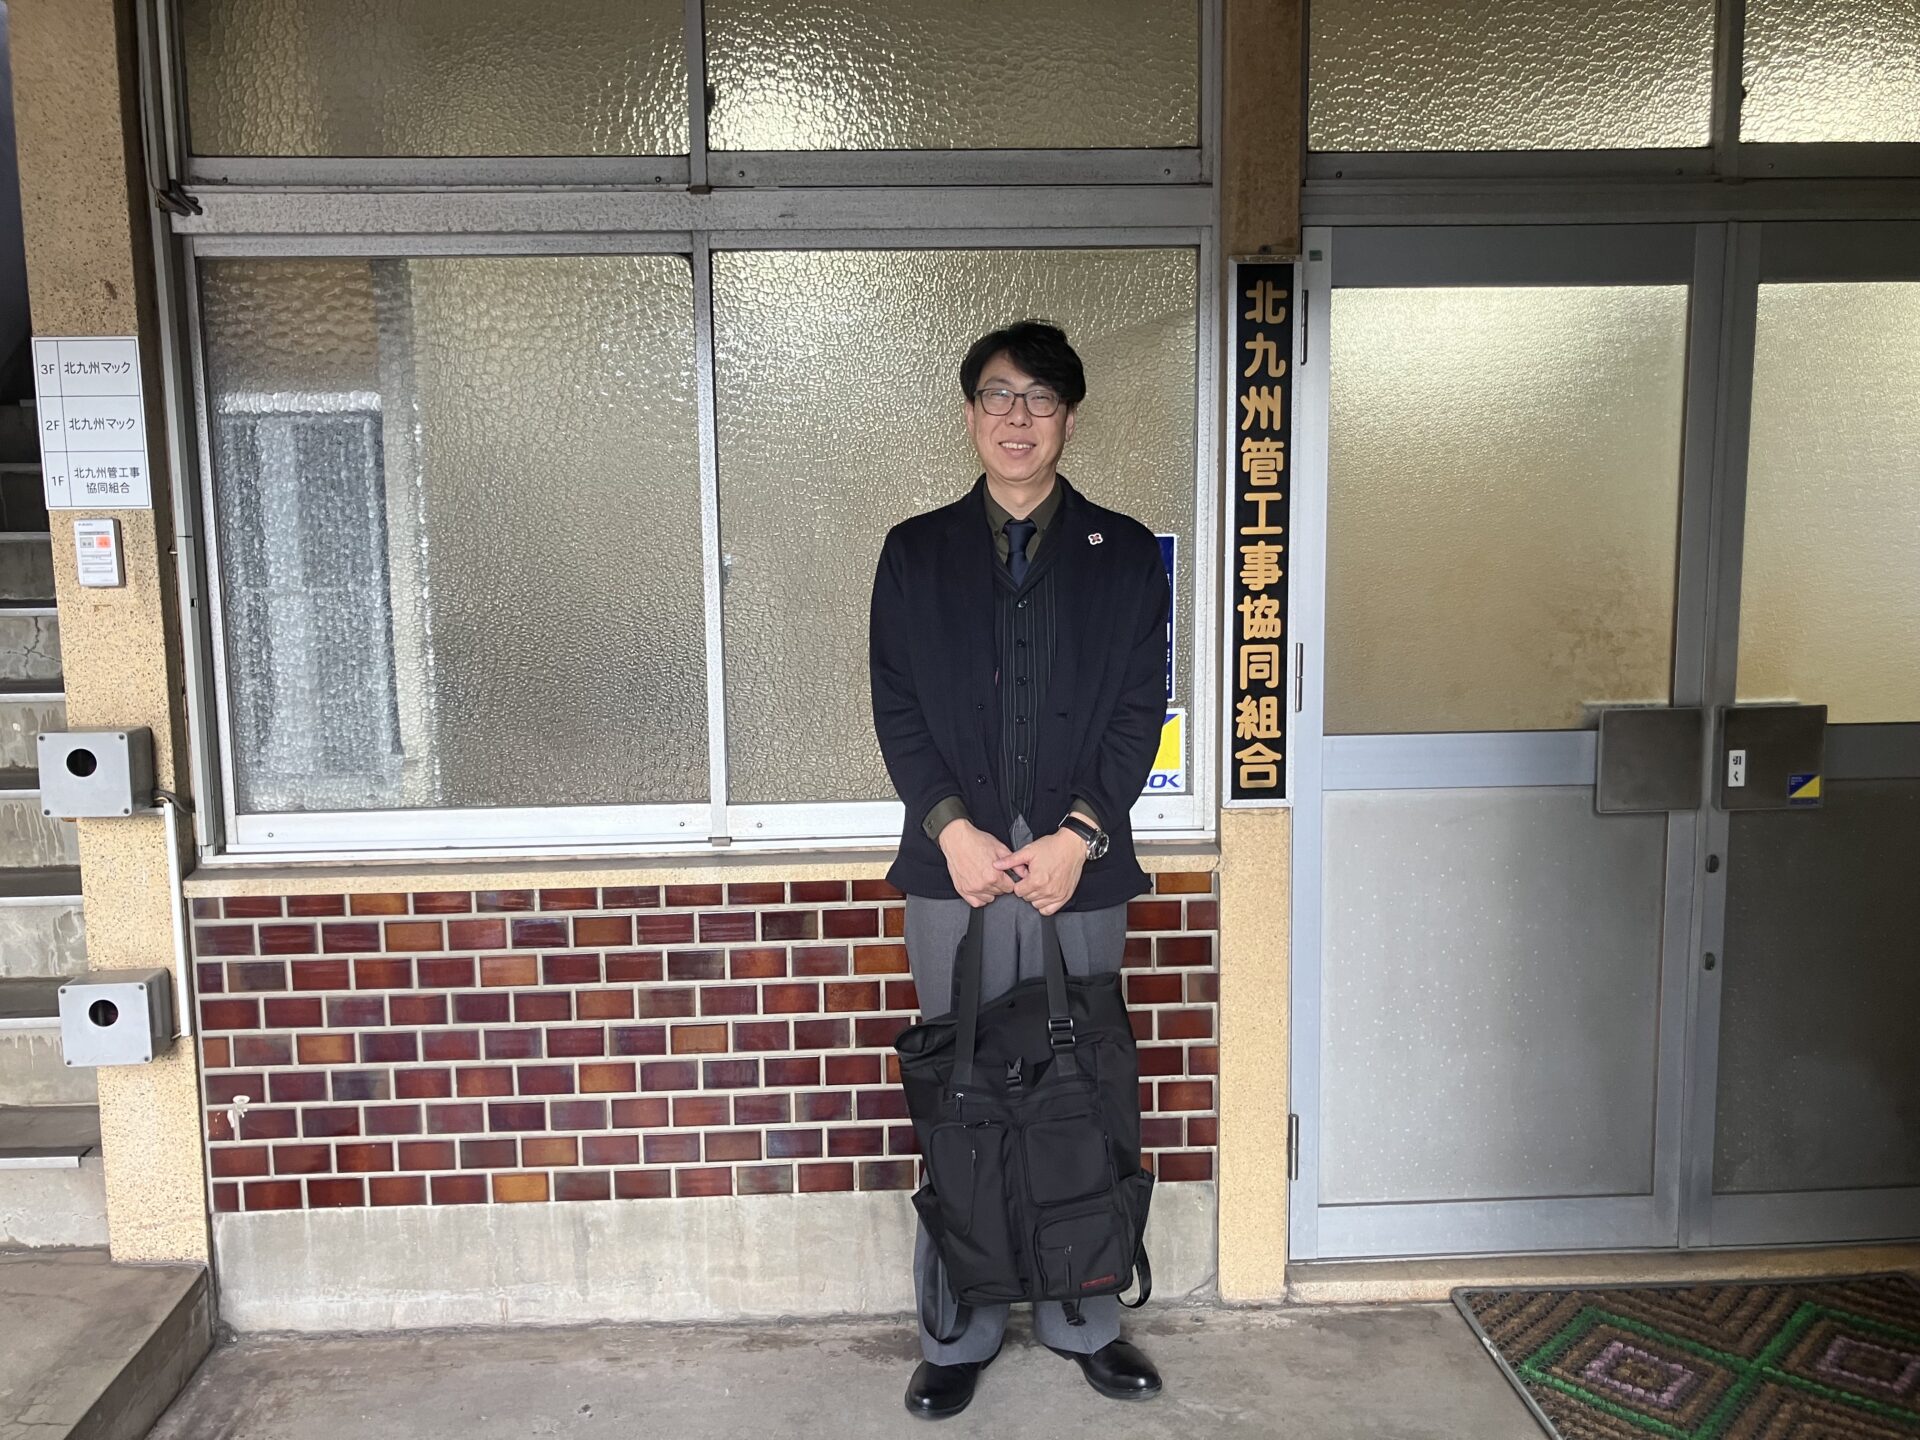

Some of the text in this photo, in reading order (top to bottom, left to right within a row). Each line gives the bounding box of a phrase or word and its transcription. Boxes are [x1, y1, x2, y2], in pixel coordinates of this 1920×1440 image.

[40, 361, 131, 375] 3F 北九州マック
[45, 417, 136, 431] 2F 北九州マック
[74, 466, 140, 479] 北九州管工事
[51, 475, 65, 487] 1F
[86, 482, 131, 494] 協同組合
[1234, 279, 1287, 789] 北九州管工事協同組合
[1732, 755, 1742, 782] 引く
[1144, 774, 1180, 789] OK
